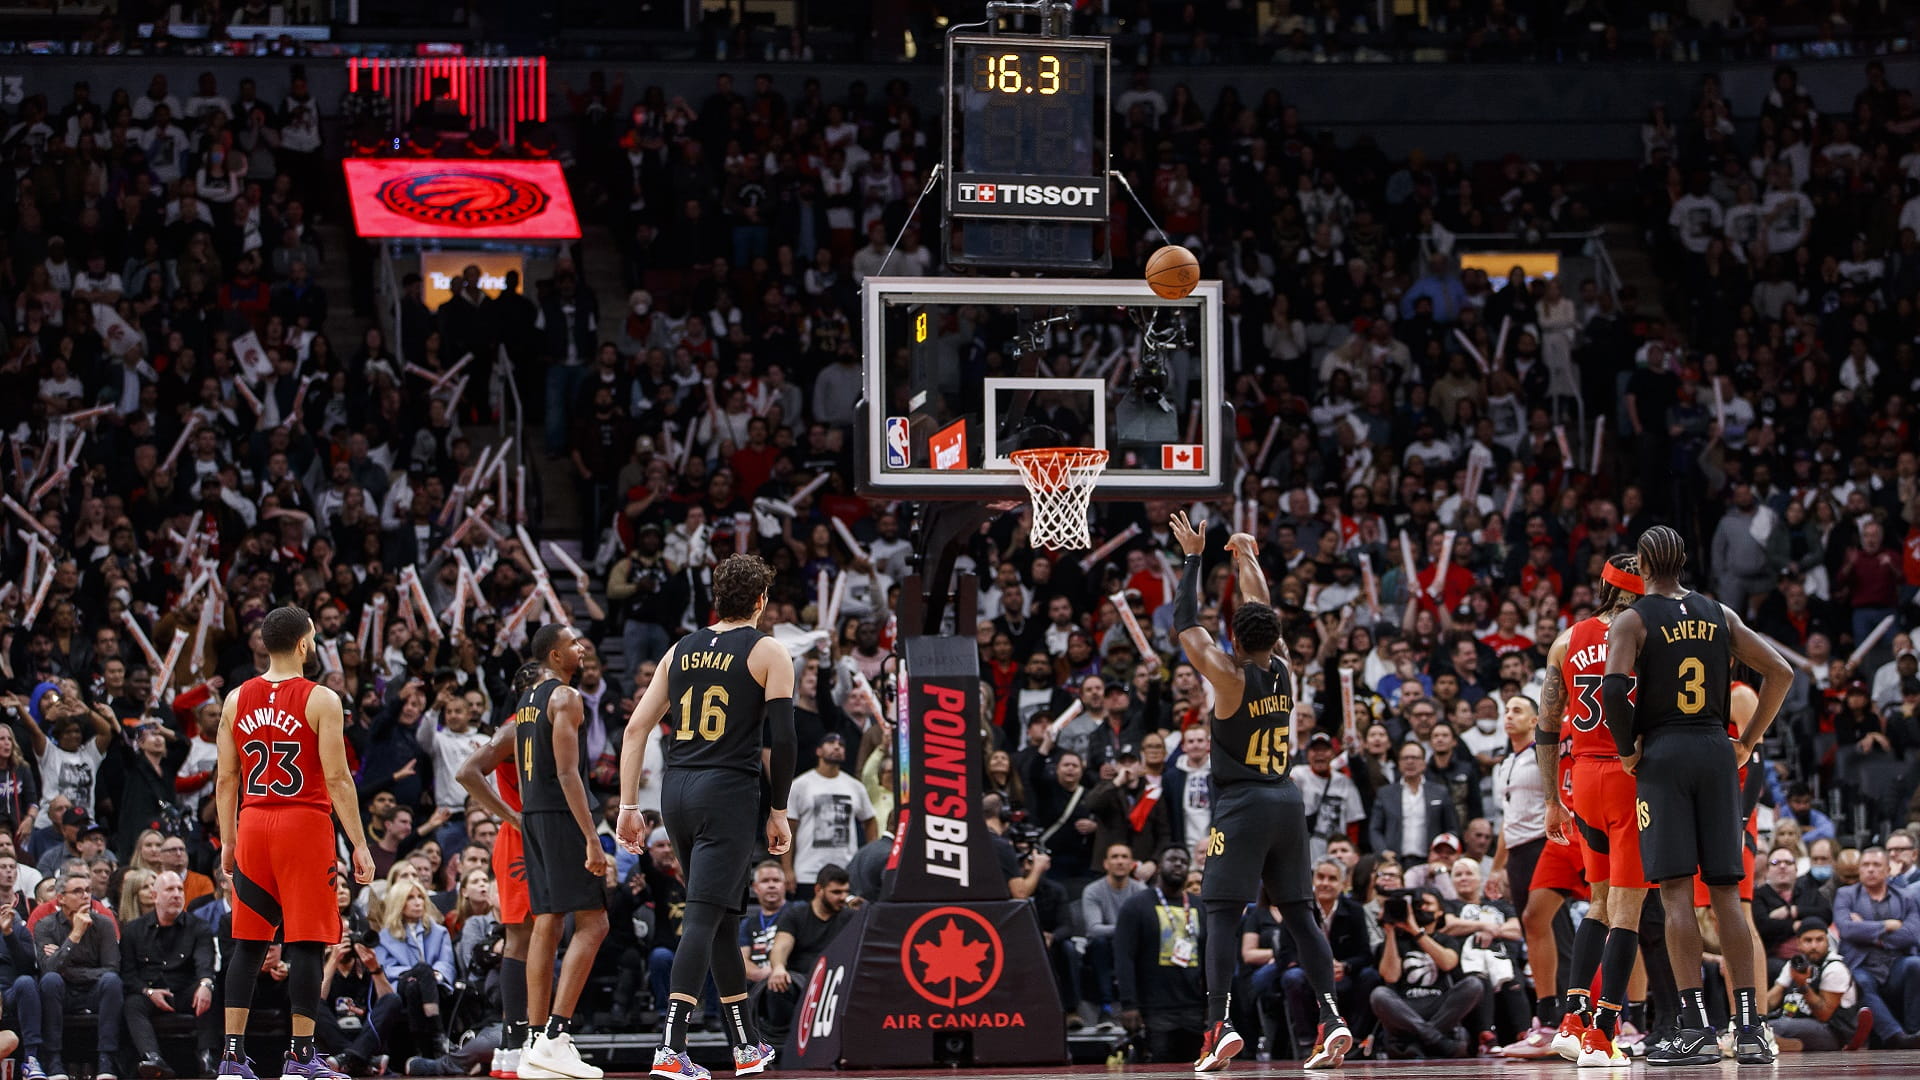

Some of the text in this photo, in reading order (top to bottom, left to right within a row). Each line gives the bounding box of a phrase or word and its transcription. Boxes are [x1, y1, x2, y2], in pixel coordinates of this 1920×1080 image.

[988, 54, 1060, 95] 16.3
[997, 184, 1100, 207] TISSOT
[681, 651, 735, 673] OSMAN
[1569, 643, 1609, 671] TREN
[1677, 656, 1707, 715] 3
[238, 707, 303, 736] VANVLEET
[676, 684, 730, 742] 16
[241, 739, 304, 797] 23
[524, 736, 534, 783] 4
[1244, 725, 1289, 776] 45
[923, 683, 970, 888] POINTSBET
[812, 964, 845, 1038] LG
[882, 1012, 1026, 1030] AIR CANADA
